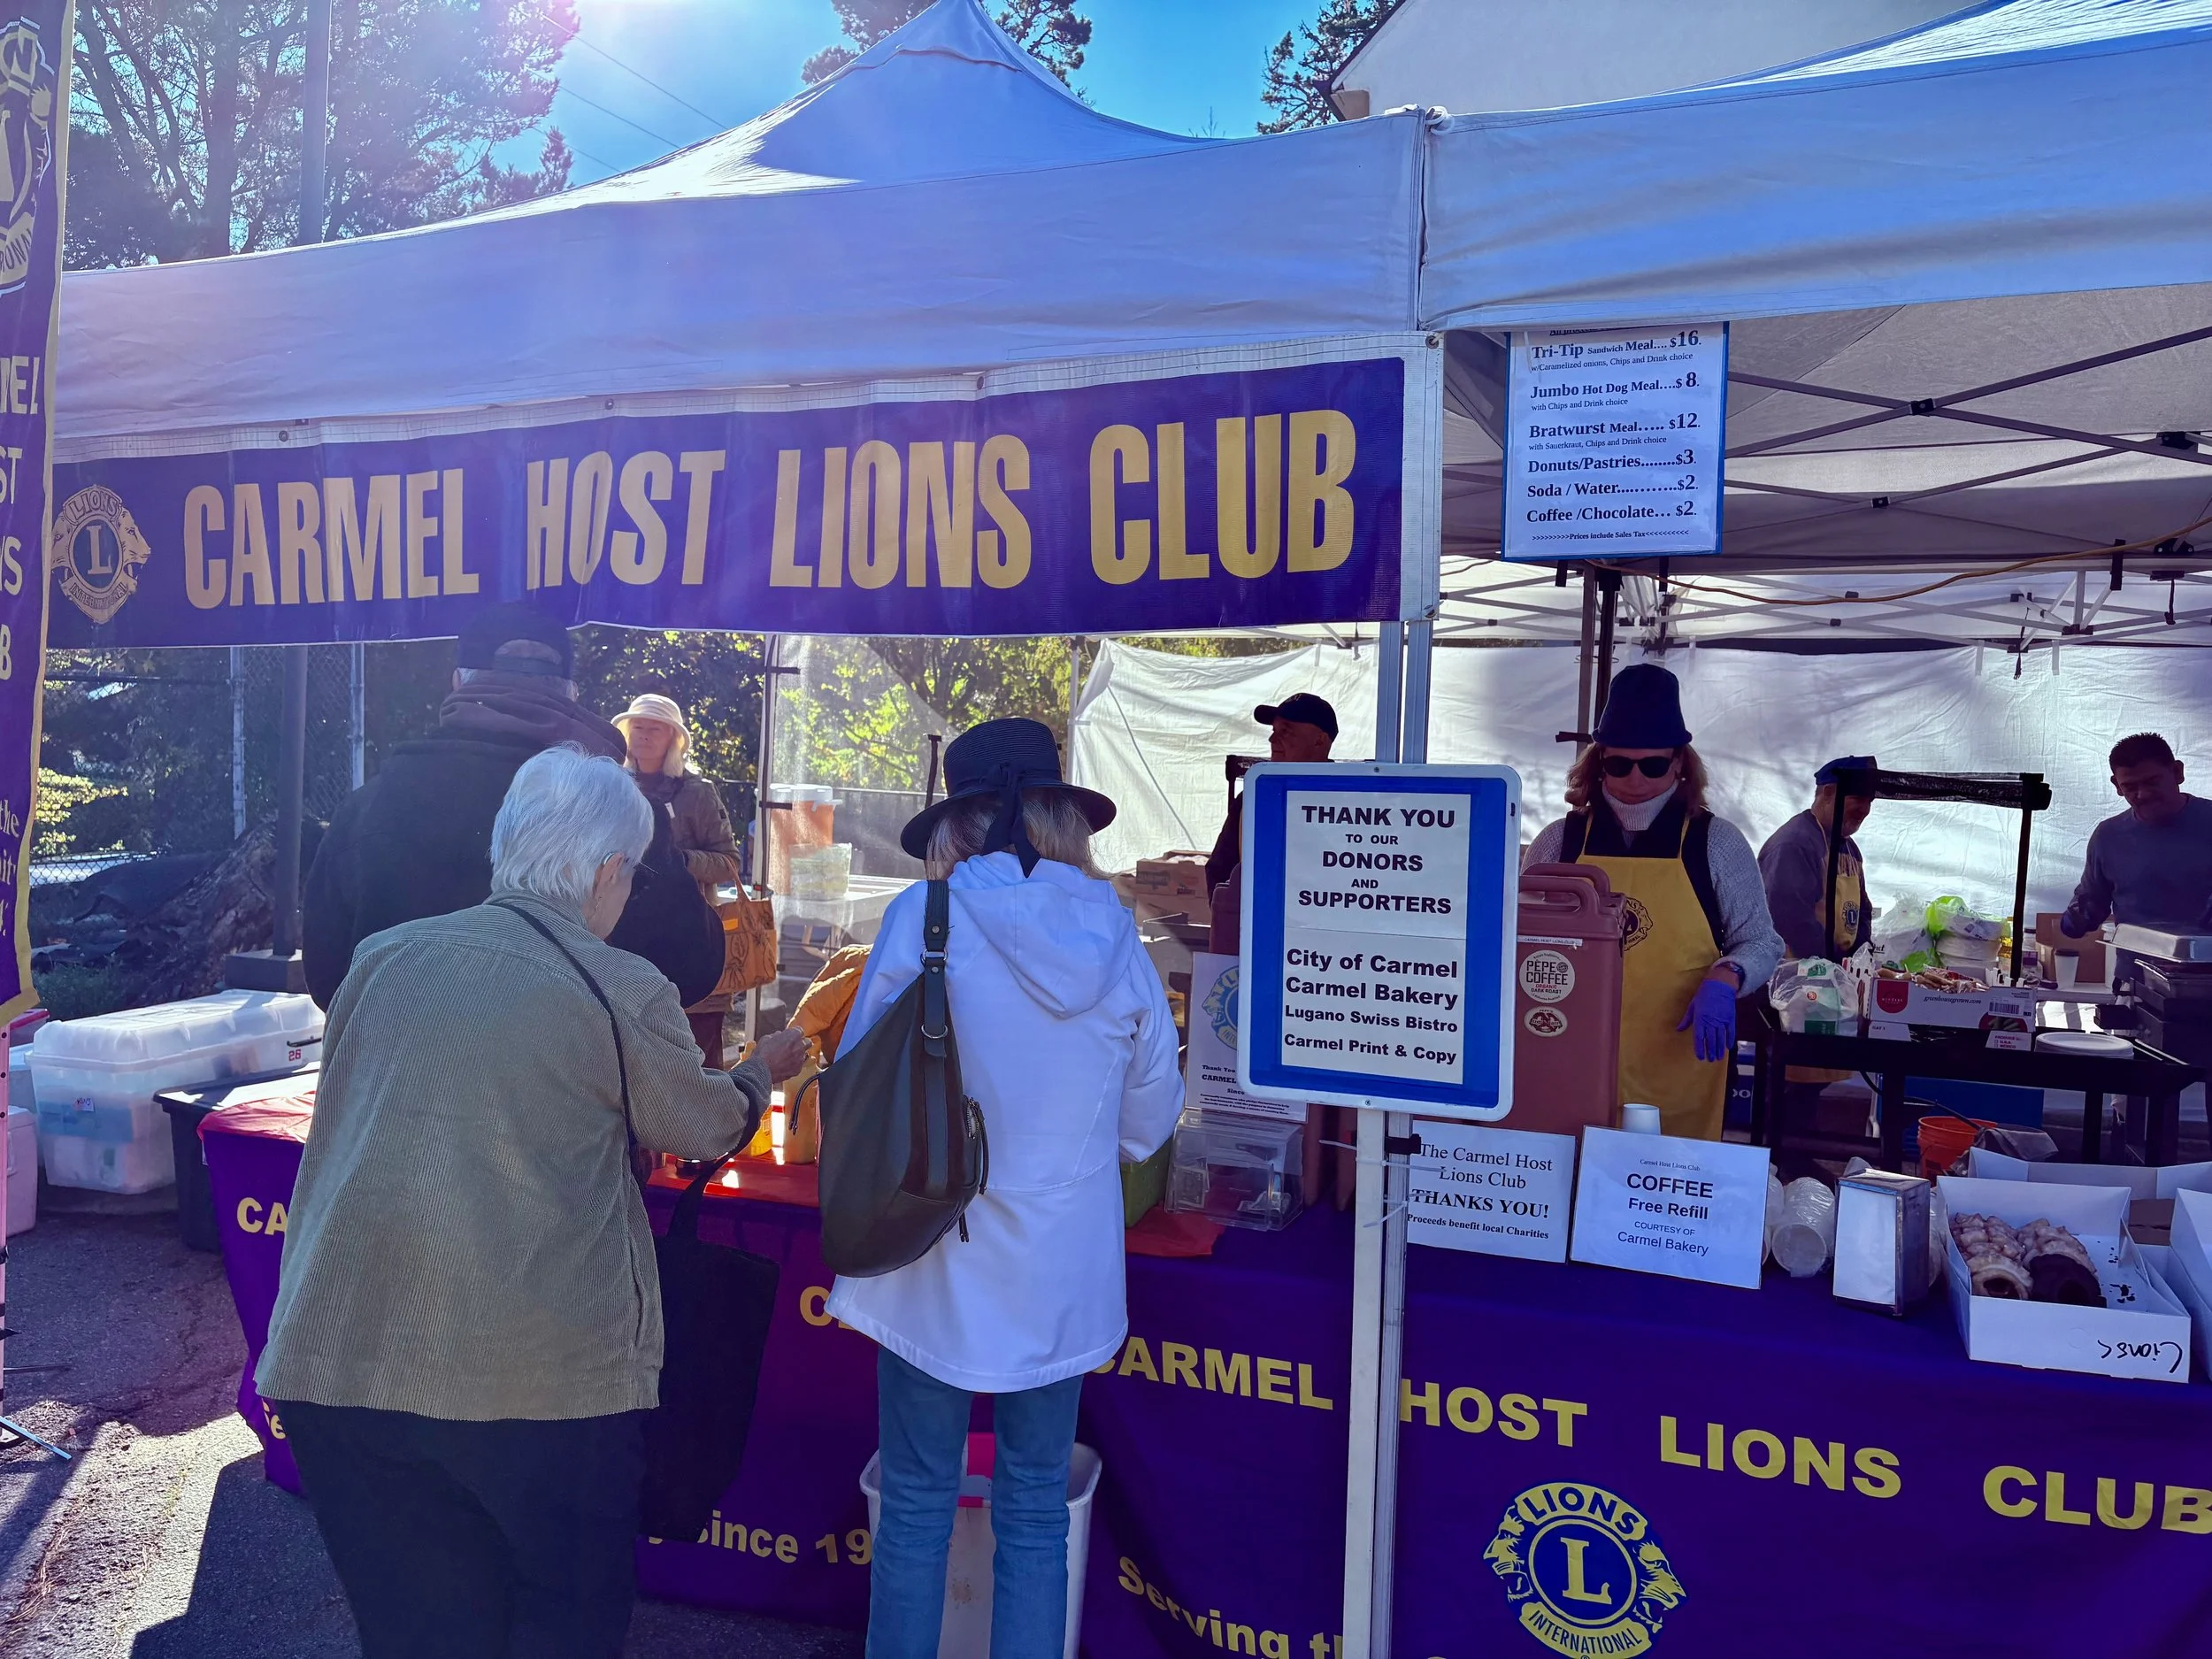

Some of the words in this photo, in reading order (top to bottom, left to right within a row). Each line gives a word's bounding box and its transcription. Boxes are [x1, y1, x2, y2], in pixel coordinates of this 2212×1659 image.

[1532, 343, 1584, 359] Tri-Tip
[1587, 345, 1624, 355] Sandwich
[1532, 361, 1581, 372] w/Caramelized
[1583, 358, 1609, 368] onions,
[1610, 356, 1631, 366] Chips
[1647, 354, 1668, 363] Drink
[1670, 352, 1694, 361] choice
[1531, 383, 1579, 399] Jumbo
[1582, 384, 1602, 395] Hot
[1605, 383, 1628, 395] Dog
[1532, 402, 1547, 411] with
[1548, 401, 1568, 411] Chips
[1570, 400, 1582, 409] and
[1584, 398, 1604, 408] Drink
[1605, 397, 1628, 406] choice
[1529, 422, 1606, 438] Bratwurst
[1528, 442, 1544, 450] with
[1545, 440, 1584, 449] Sauerkraut,
[1586, 438, 1606, 449] Chips
[1607, 438, 1620, 447] and
[1621, 436, 1642, 445] Drink
[1643, 435, 1667, 444] choice
[1527, 484, 1562, 498] Soda
[68, 490, 119, 520] LIONS
[183, 468, 479, 609] CARMEL
[526, 449, 726, 591] HOST
[769, 434, 1032, 589] LIONS
[1090, 409, 1356, 585] CLUB
[1526, 508, 1572, 523] Coffee
[1590, 531, 1614, 540] include
[1615, 530, 1632, 539] Sales
[86, 525, 112, 574] L
[1302, 805, 1392, 826] THANK
[1401, 809, 1455, 828] YOU
[1345, 833, 1363, 843] TO
[1371, 835, 1399, 845] OUR
[1322, 851, 1424, 872] DONORS
[1351, 879, 1379, 889] AND
[1298, 890, 1452, 914] SUPPORTERS
[1286, 948, 1332, 971] City
[1340, 954, 1363, 971] of
[1370, 956, 1458, 978] Carmel
[1526, 972, 1568, 986] COFFEE
[1286, 977, 1366, 999] Carmel
[1374, 984, 1458, 1010] Bakery
[1285, 1005, 1345, 1023] Lugano
[1349, 1010, 1400, 1027] Swiss
[1405, 1016, 1458, 1033] Bistro
[1284, 1033, 1343, 1051] Carmel
[1348, 1040, 1388, 1056] Print
[1394, 1045, 1407, 1057] &
[1413, 1046, 1456, 1065] Copy
[1202, 1074, 1237, 1084] CARMEL
[1420, 1143, 1448, 1159] The
[1453, 1147, 1509, 1166] Carmel
[1516, 1153, 1553, 1171] Host
[1439, 1165, 1483, 1185] Lions
[1488, 1171, 1527, 1190] Club
[1626, 1172, 1714, 1199] COFFEE
[1412, 1188, 1494, 1212] THANKS
[1499, 1200, 1549, 1219] YOU!
[1628, 1197, 1663, 1217] Free
[1668, 1202, 1709, 1220] Refill
[1407, 1213, 1447, 1228] Proceeds
[1448, 1217, 1479, 1233] benefit
[1482, 1221, 1504, 1234] local
[1506, 1224, 1549, 1240] Charities
[1634, 1220, 1680, 1235] COURTESY
[1682, 1226, 1695, 1236] OF
[1617, 1231, 1662, 1248] Carmel
[1665, 1237, 1709, 1257] Bakery
[1091, 1336, 1333, 1409] ARMEL
[1401, 1379, 1587, 1448] HOST
[1660, 1415, 1901, 1498] LIONS
[1983, 1464, 2212, 1536] CLUB
[1522, 1486, 1643, 1534] LIONS
[697, 1509, 798, 1563] ince
[1560, 1535, 1612, 1605] L
[1527, 1608, 1643, 1654] INTERNATIONAL
